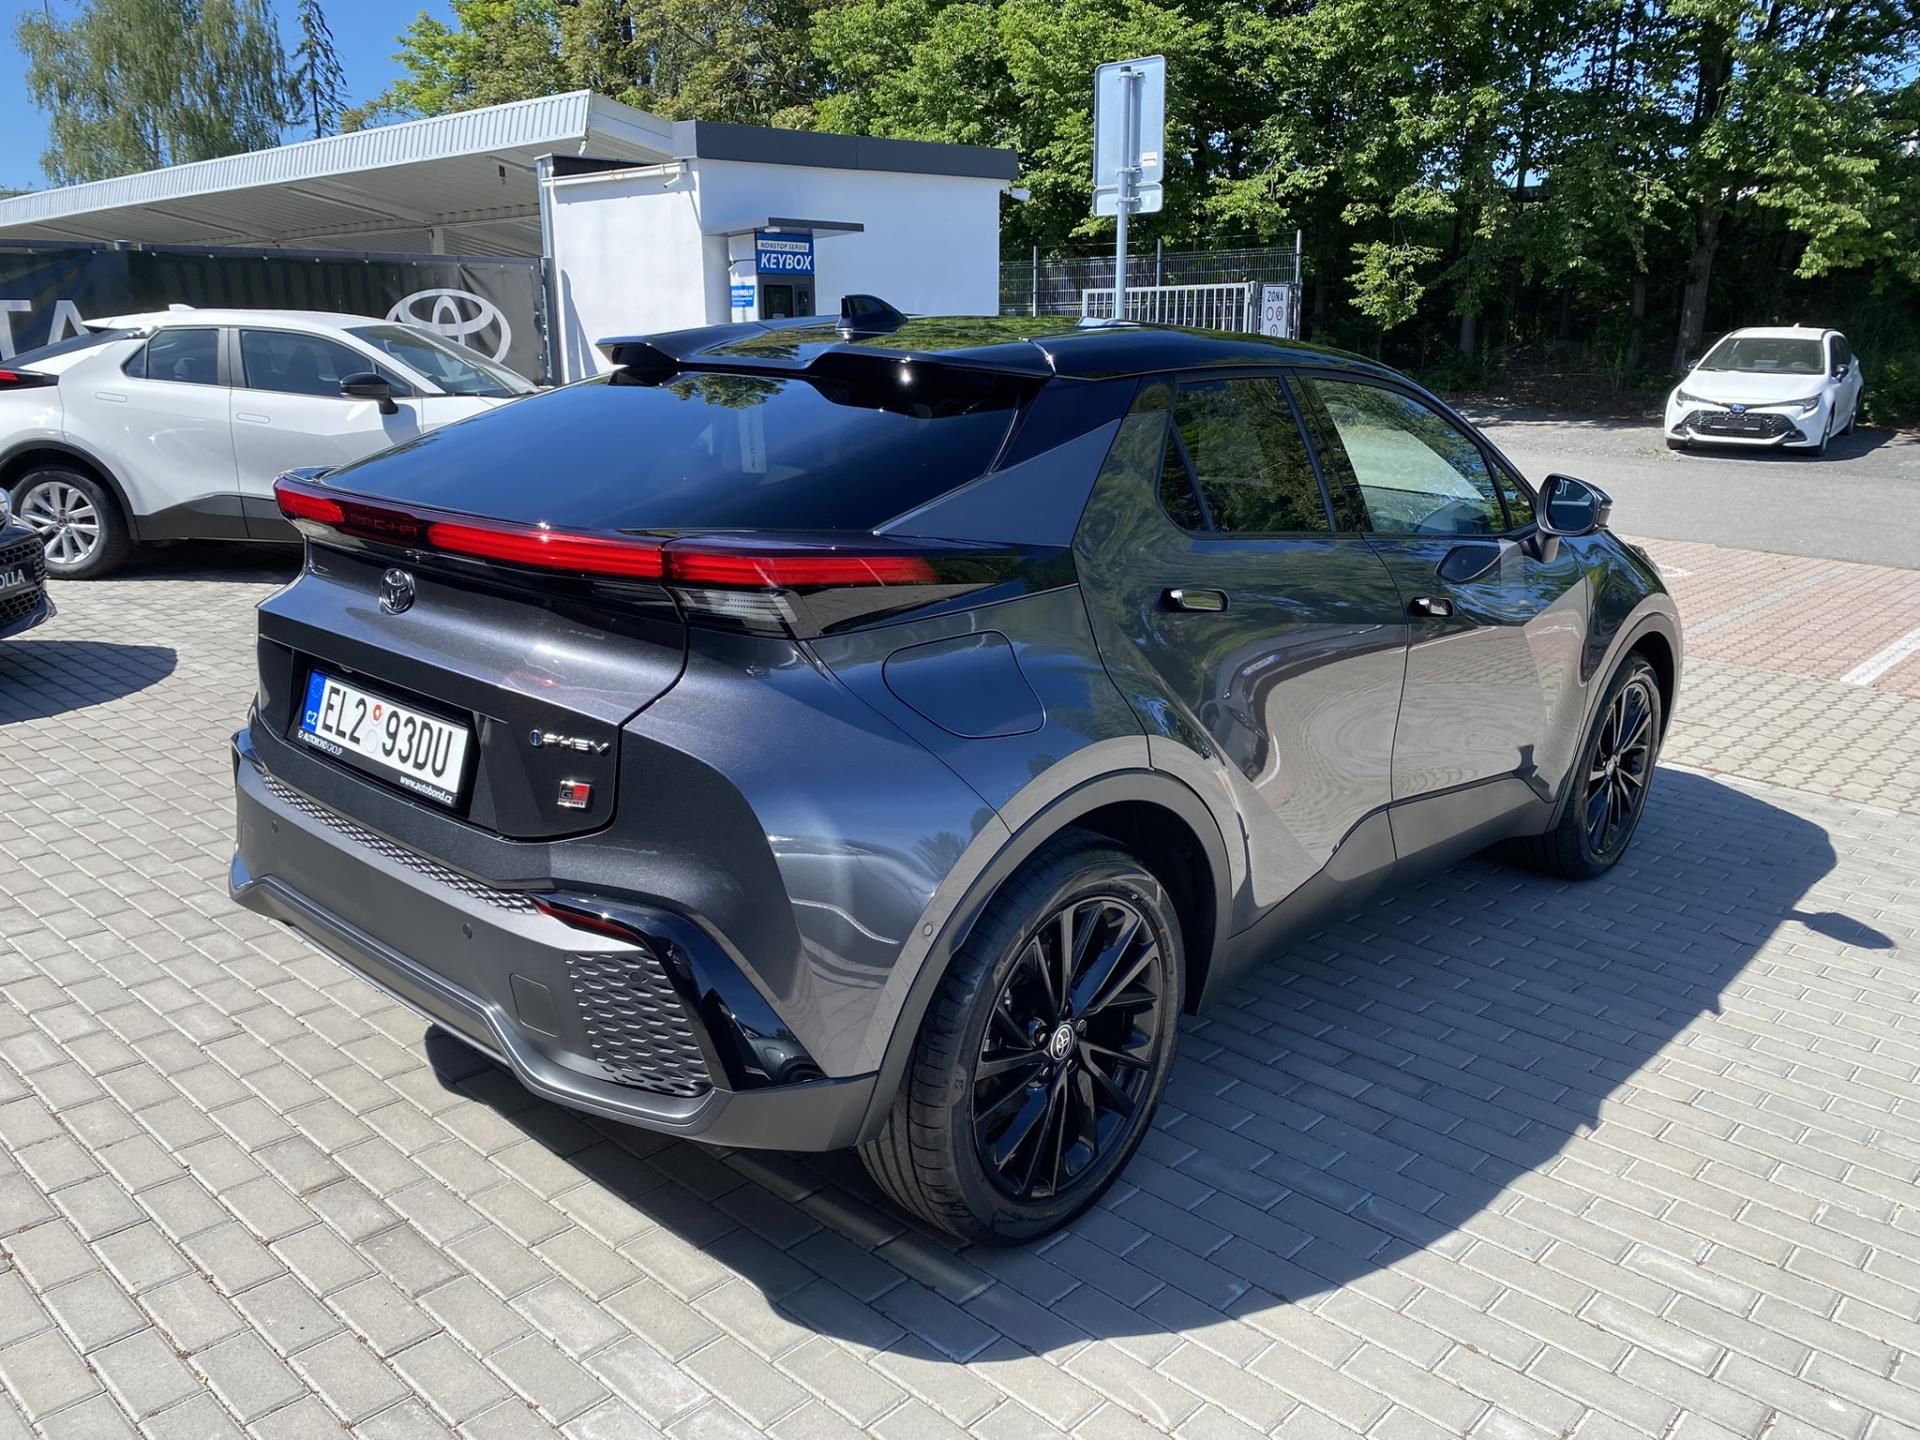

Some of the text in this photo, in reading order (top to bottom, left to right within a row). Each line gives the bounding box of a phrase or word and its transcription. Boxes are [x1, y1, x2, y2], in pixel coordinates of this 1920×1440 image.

[760, 241, 788, 250] NONSTOP
[760, 252, 812, 270] KEYBOX
[1267, 290, 1284, 303] ZONA
[305, 710, 318, 726] CZ
[321, 685, 453, 778] EL2 93DU
